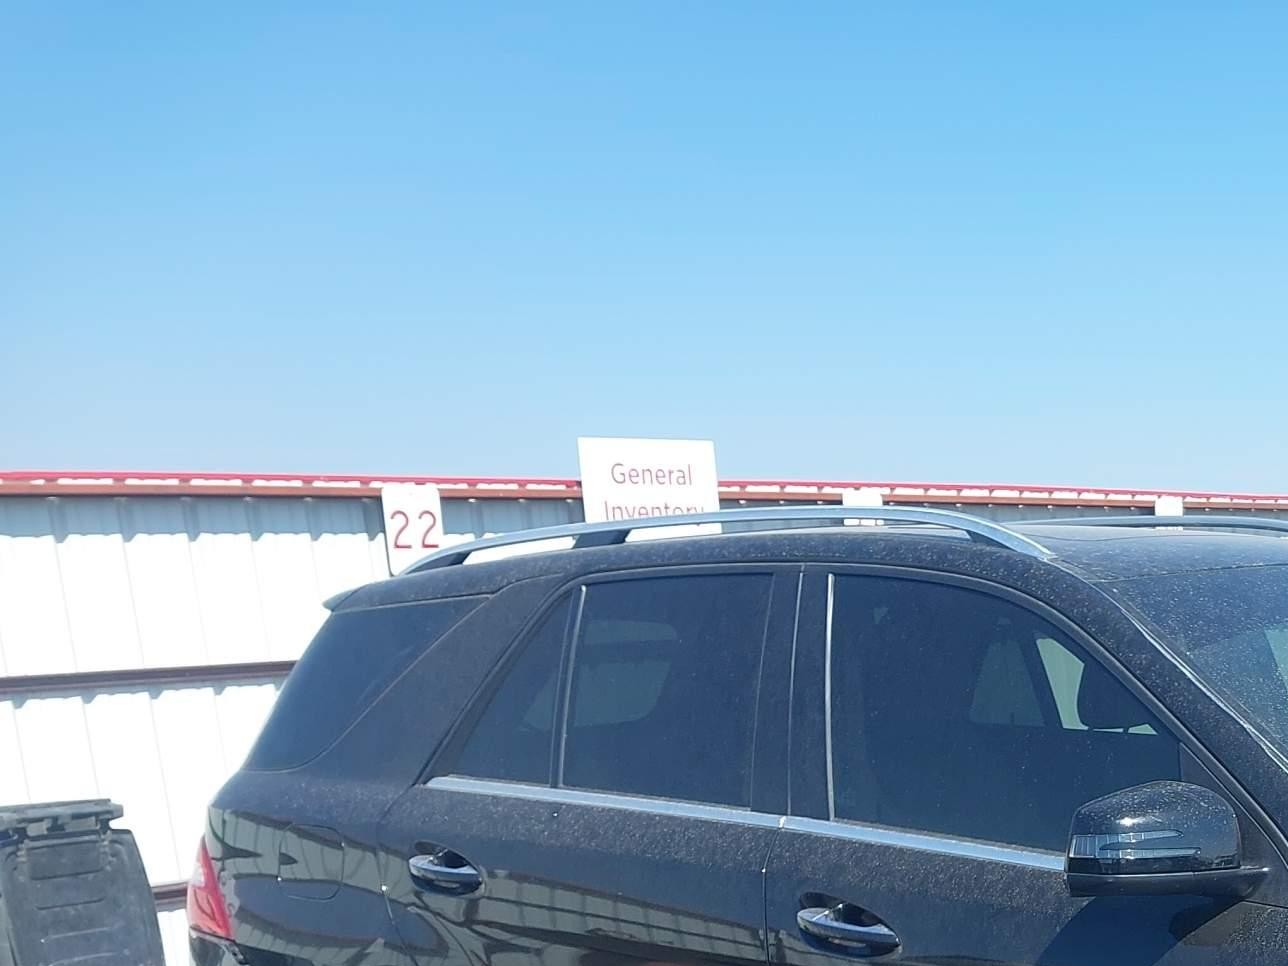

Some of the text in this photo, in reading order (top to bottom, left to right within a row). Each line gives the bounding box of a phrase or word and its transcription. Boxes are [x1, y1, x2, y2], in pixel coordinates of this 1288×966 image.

[610, 462, 692, 486] General
[604, 500, 704, 520] Invent
[390, 510, 439, 549] 22
